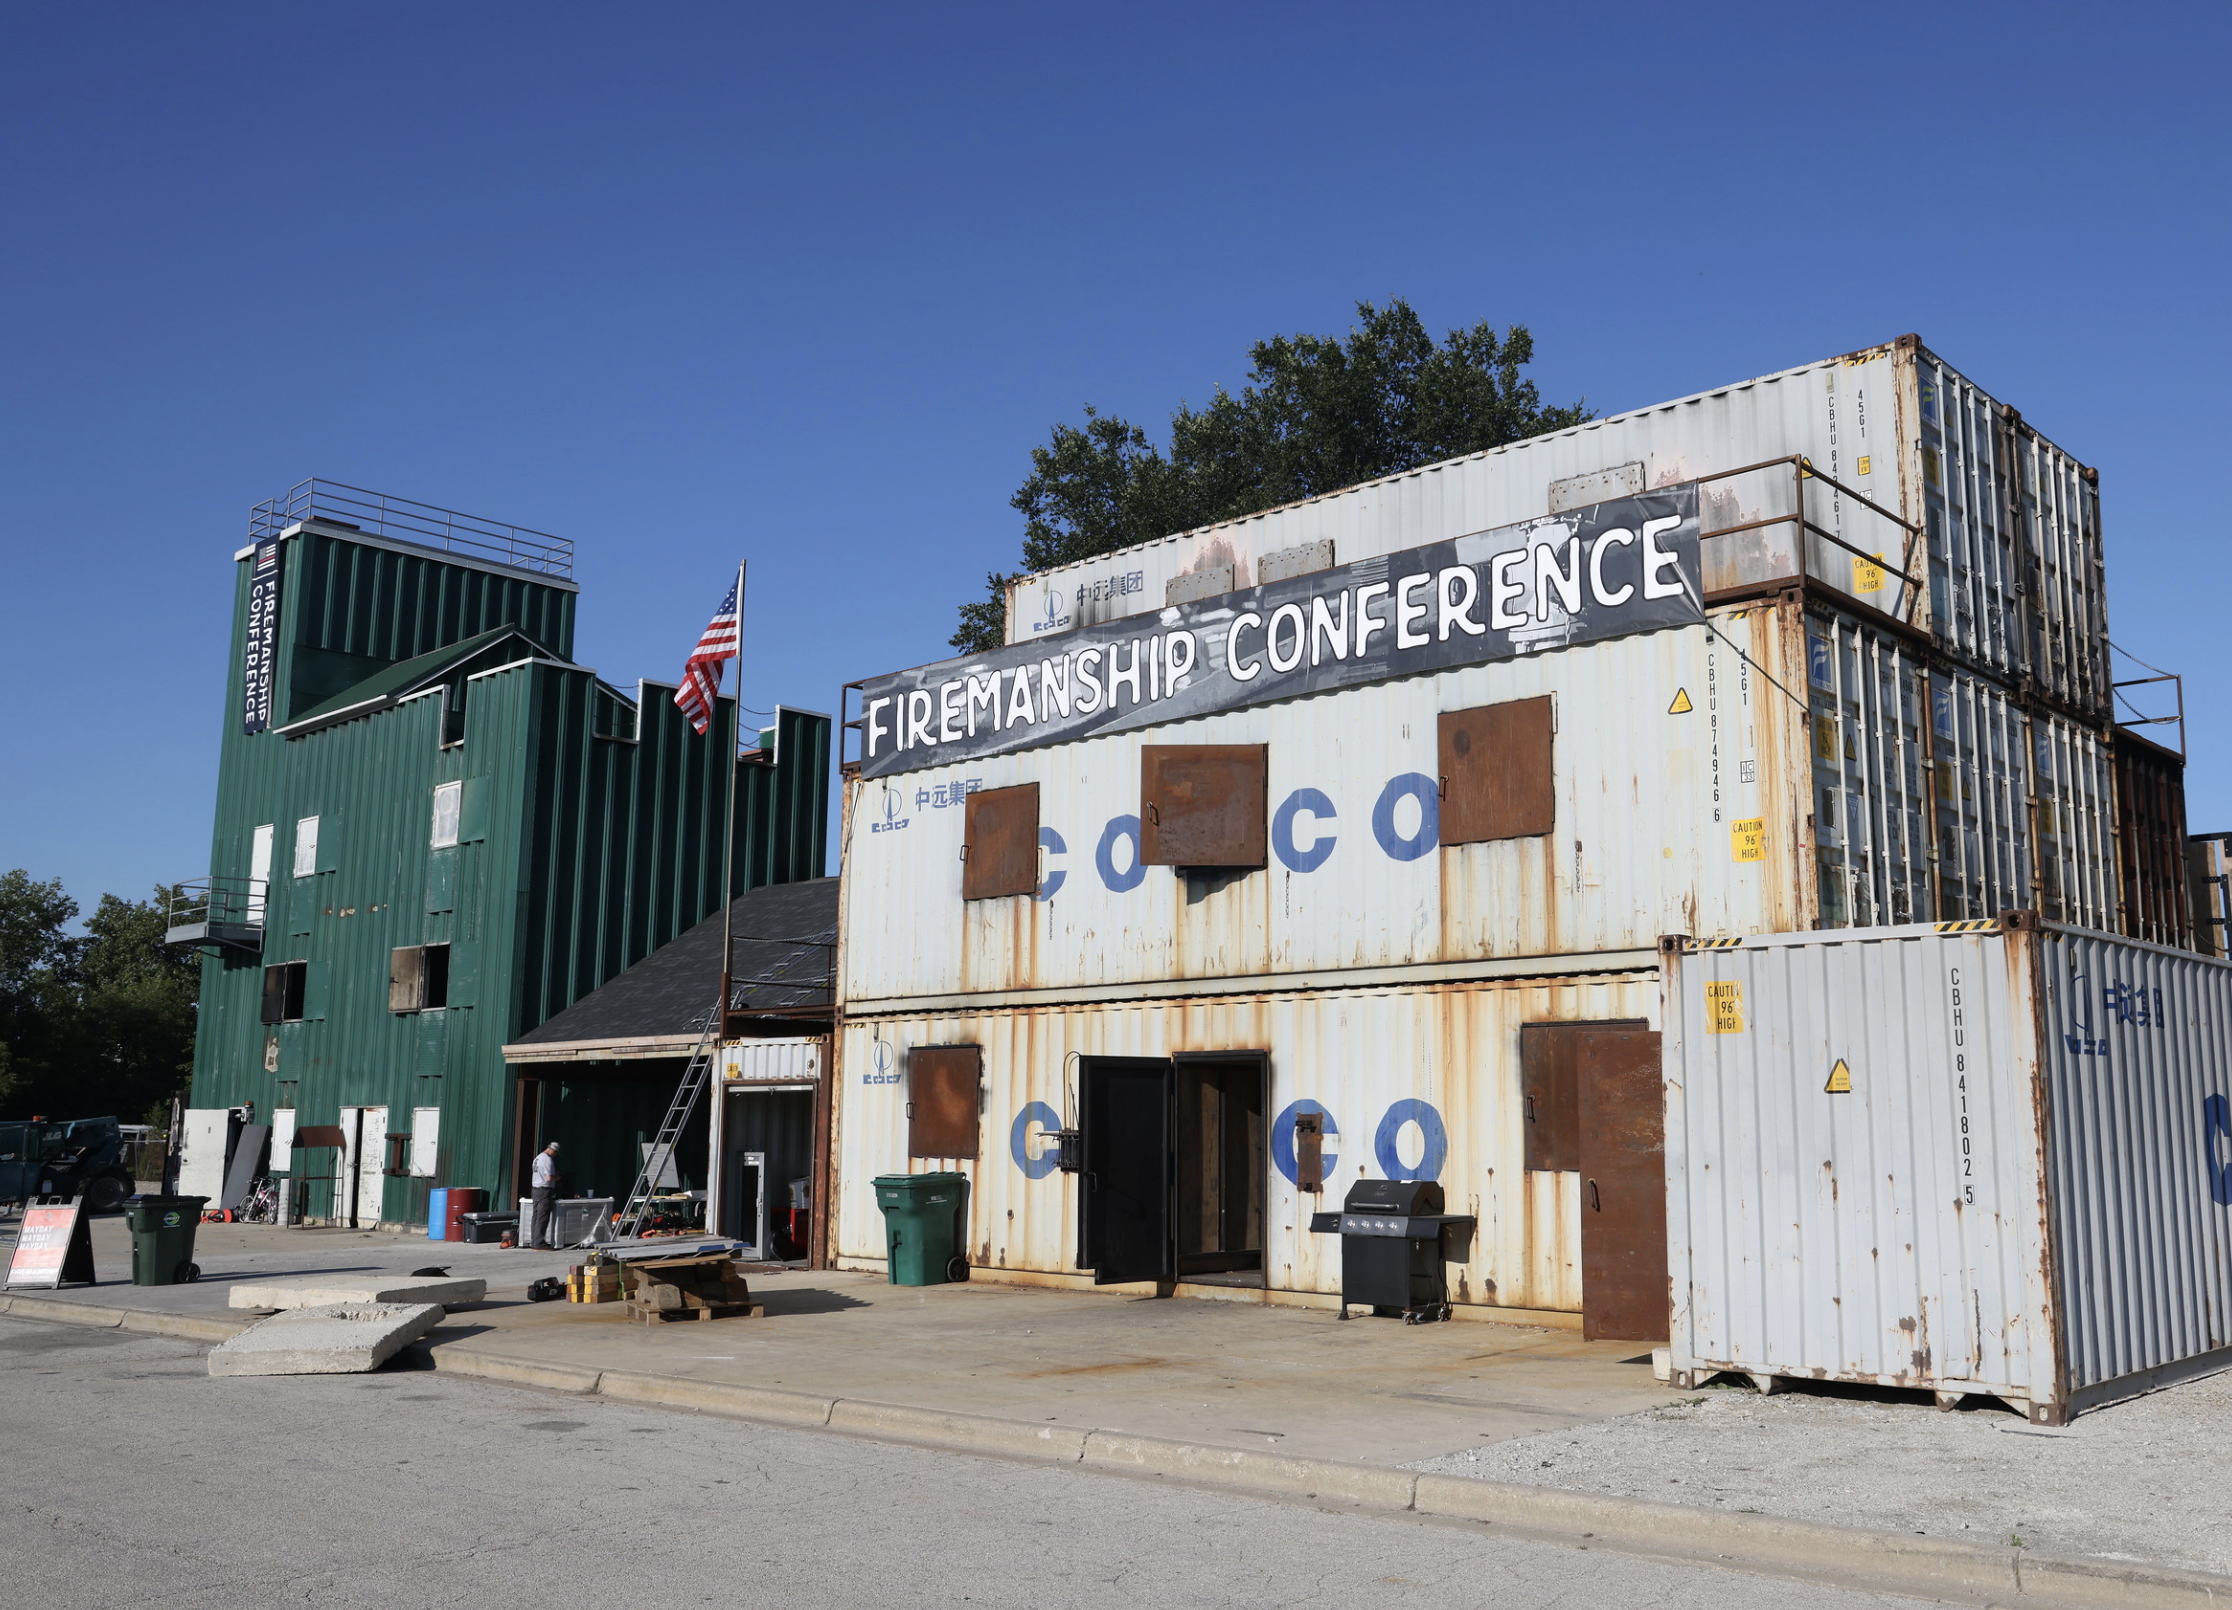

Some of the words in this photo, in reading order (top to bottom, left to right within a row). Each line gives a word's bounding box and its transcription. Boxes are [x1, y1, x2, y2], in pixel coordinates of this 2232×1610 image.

[1077, 571, 1143, 607] 中远集团
[1863, 580, 1878, 590] HIGH
[246, 584, 263, 723] CONFERENCE
[258, 580, 275, 721] FIREMANSHIP
[869, 631, 1197, 758] FIREMANSHIP
[1227, 514, 1685, 682] CONFERENCE
[1708, 654, 1716, 711] CBHU
[1711, 714, 1719, 802] 874946
[1733, 820, 1763, 833] CAUTION
[1741, 847, 1759, 859] HIGH
[1951, 967, 1964, 1047] CBHU
[1957, 1053, 1972, 1176] 841802
[42, 1132, 62, 1141] JLG
[1965, 1185, 1973, 1204] 5
[22, 1234, 52, 1242] MAYDAY
[24, 1225, 54, 1234] MAYDAY
